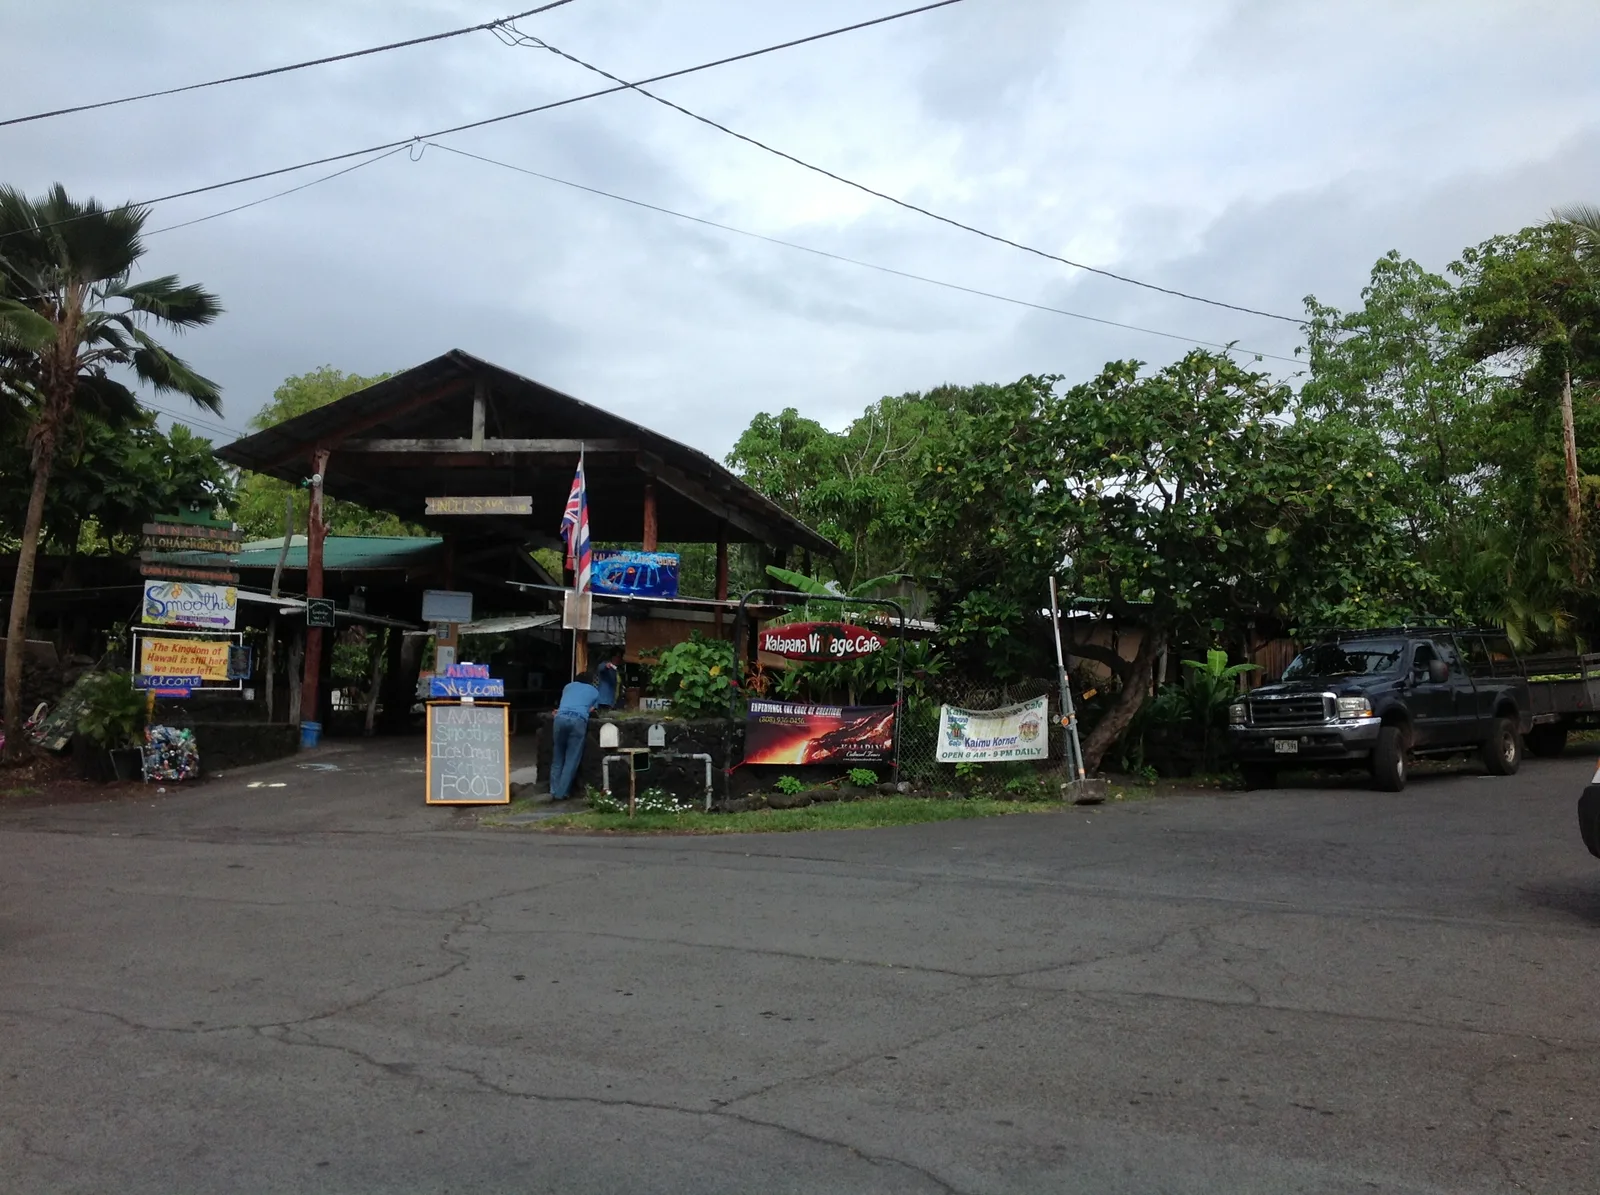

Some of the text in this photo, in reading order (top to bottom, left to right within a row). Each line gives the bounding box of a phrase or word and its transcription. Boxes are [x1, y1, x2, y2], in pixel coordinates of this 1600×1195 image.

[153, 643, 222, 655] The Kingdom of
[765, 634, 807, 654] Kalapana
[855, 636, 882, 653] Cafe
[147, 653, 229, 666] Hawaii is still here
[154, 665, 168, 673] we
[170, 665, 194, 675] never
[144, 675, 199, 687] Welcome
[436, 679, 504, 697] Welcome
[964, 736, 1018, 748] Kaimu Korner
[431, 741, 461, 758] Ice
[942, 751, 964, 759] OPEN
[1015, 747, 1042, 756] DAILY
[440, 773, 503, 799] FOOD
